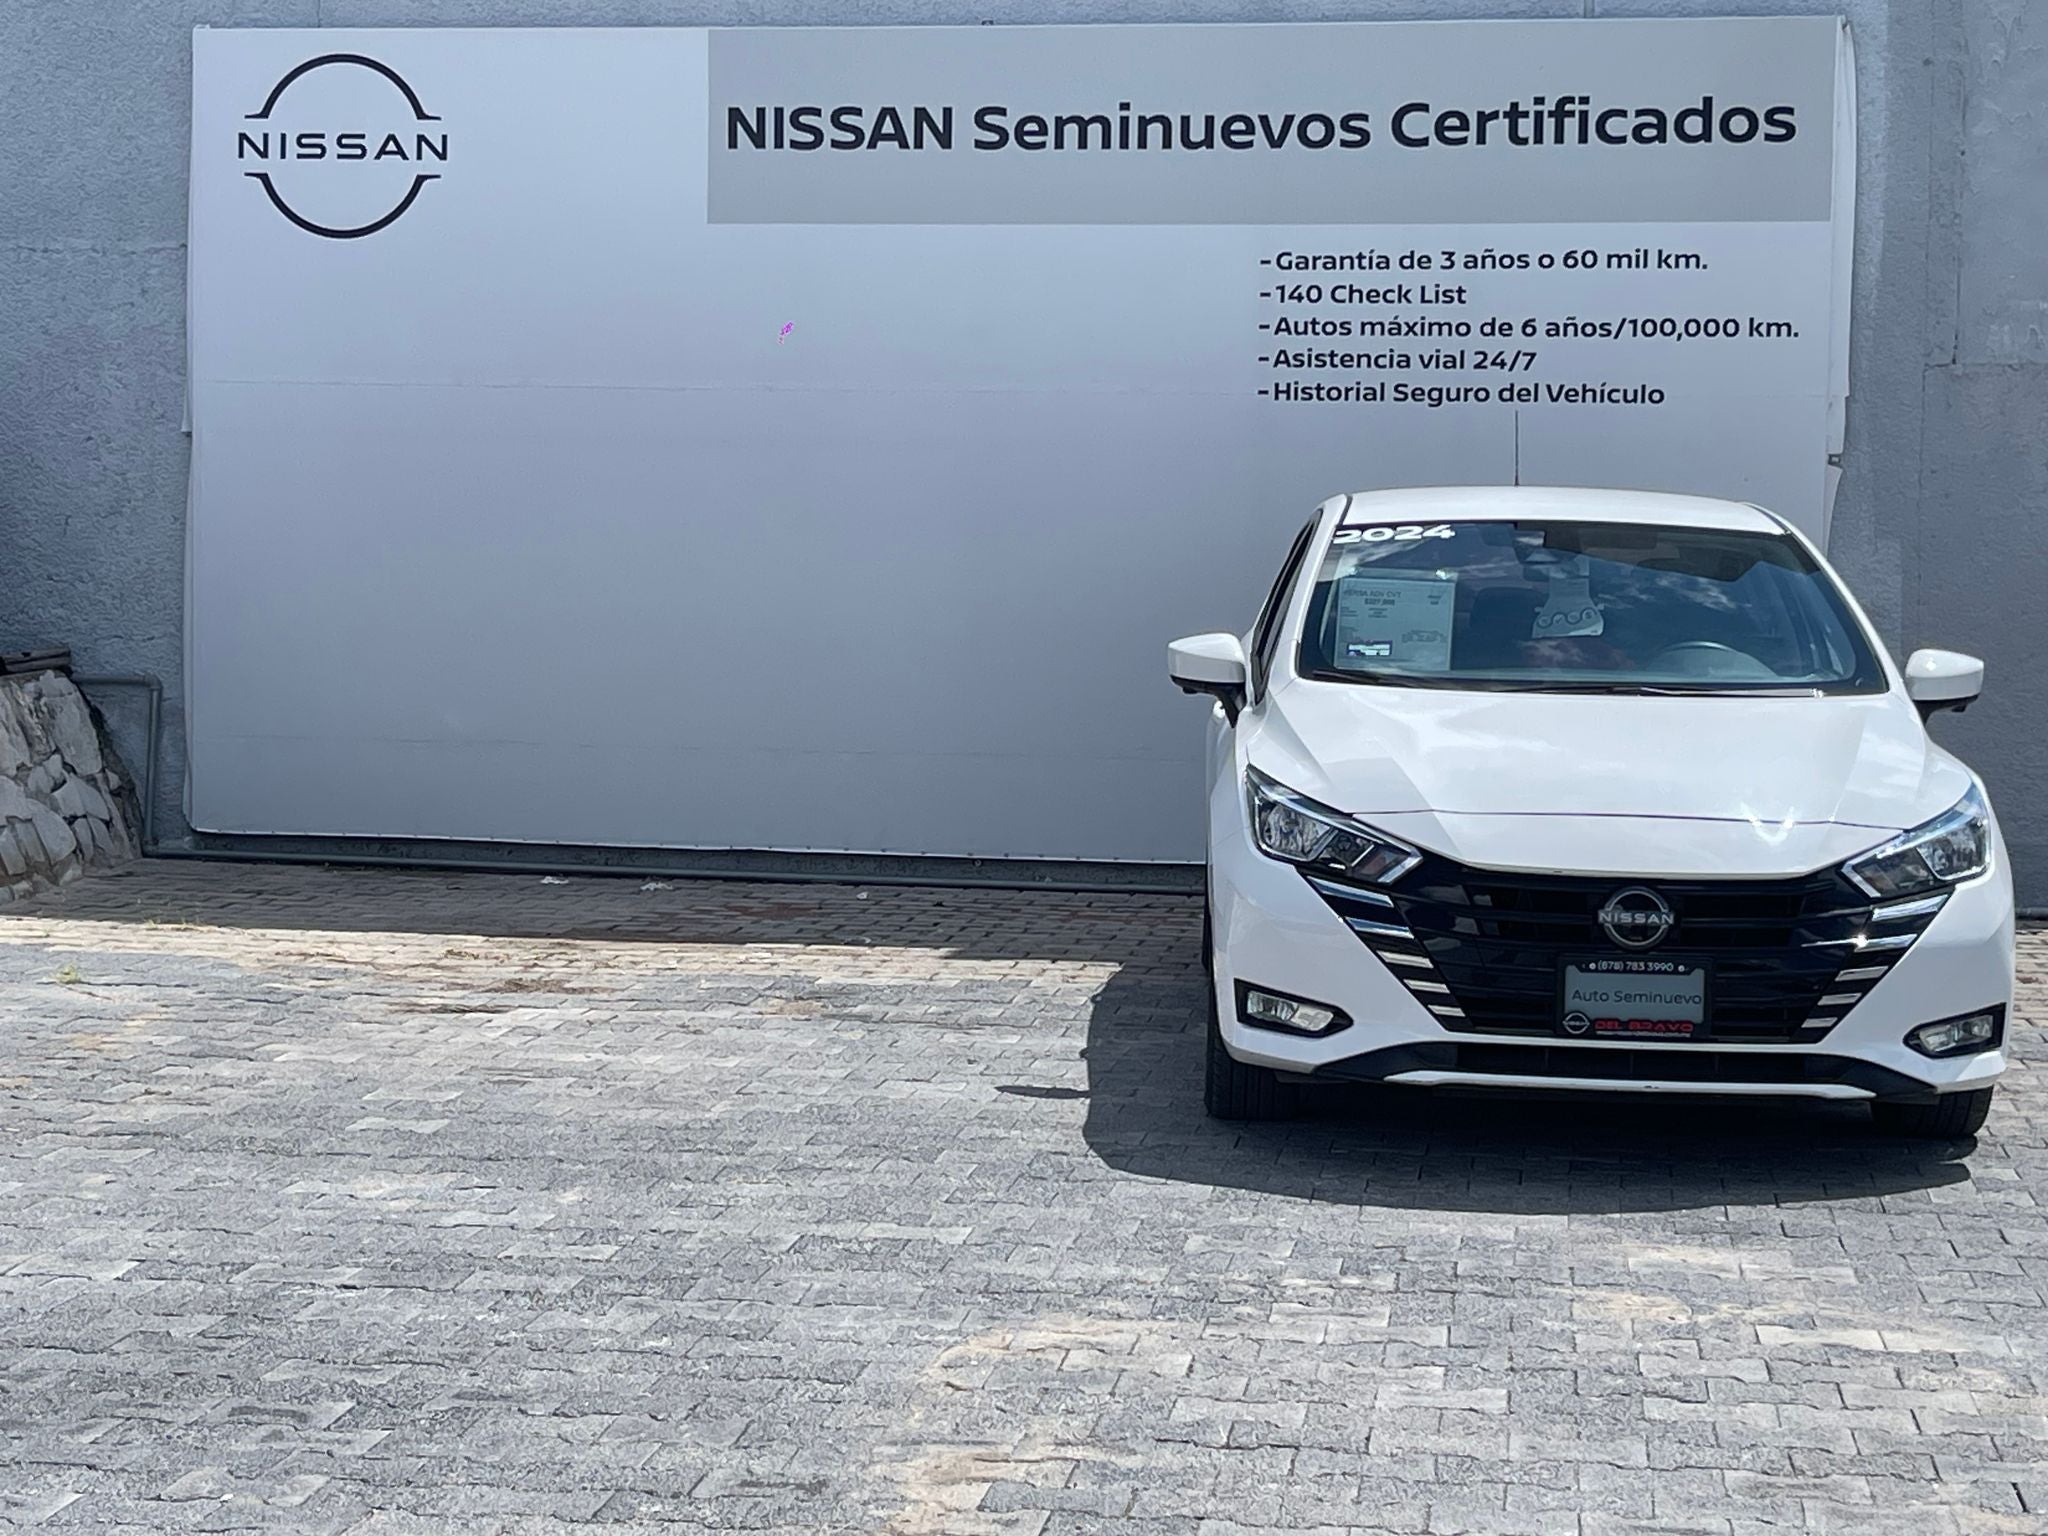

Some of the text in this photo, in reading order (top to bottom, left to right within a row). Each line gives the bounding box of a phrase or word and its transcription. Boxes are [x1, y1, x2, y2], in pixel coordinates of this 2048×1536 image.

[728, 96, 1797, 151] NISSAN Seminuevos Certificados
[238, 132, 448, 161] NISSAN
[1398, 250, 1433, 270] de
[1440, 251, 1456, 270] 3
[1463, 249, 1531, 270] años
[1537, 253, 1555, 269] o
[1562, 249, 1599, 269] 60
[1606, 248, 1649, 270] mil
[1656, 249, 1708, 270] km.
[1330, 284, 1412, 304] Check
[1420, 284, 1467, 304] List
[1360, 315, 1472, 337] máximo
[1479, 317, 1514, 337] de
[1521, 317, 1537, 337] 6
[1545, 316, 1740, 341] años/100,000
[1748, 317, 1799, 337] km.
[1419, 349, 1466, 370] vial
[1472, 349, 1538, 372] 24/7
[1392, 383, 1491, 407] Seguro
[1498, 382, 1539, 403] del
[1546, 382, 1665, 404] Vehículo
[1332, 524, 1456, 544] 2024
[1598, 911, 1675, 925] NISSAN
[1647, 962, 1674, 973] 3990
[1572, 990, 1702, 1005] Auto Seminuevo
[1594, 1020, 1622, 1030] DEL
[1628, 1021, 1694, 1032] BRAVO
